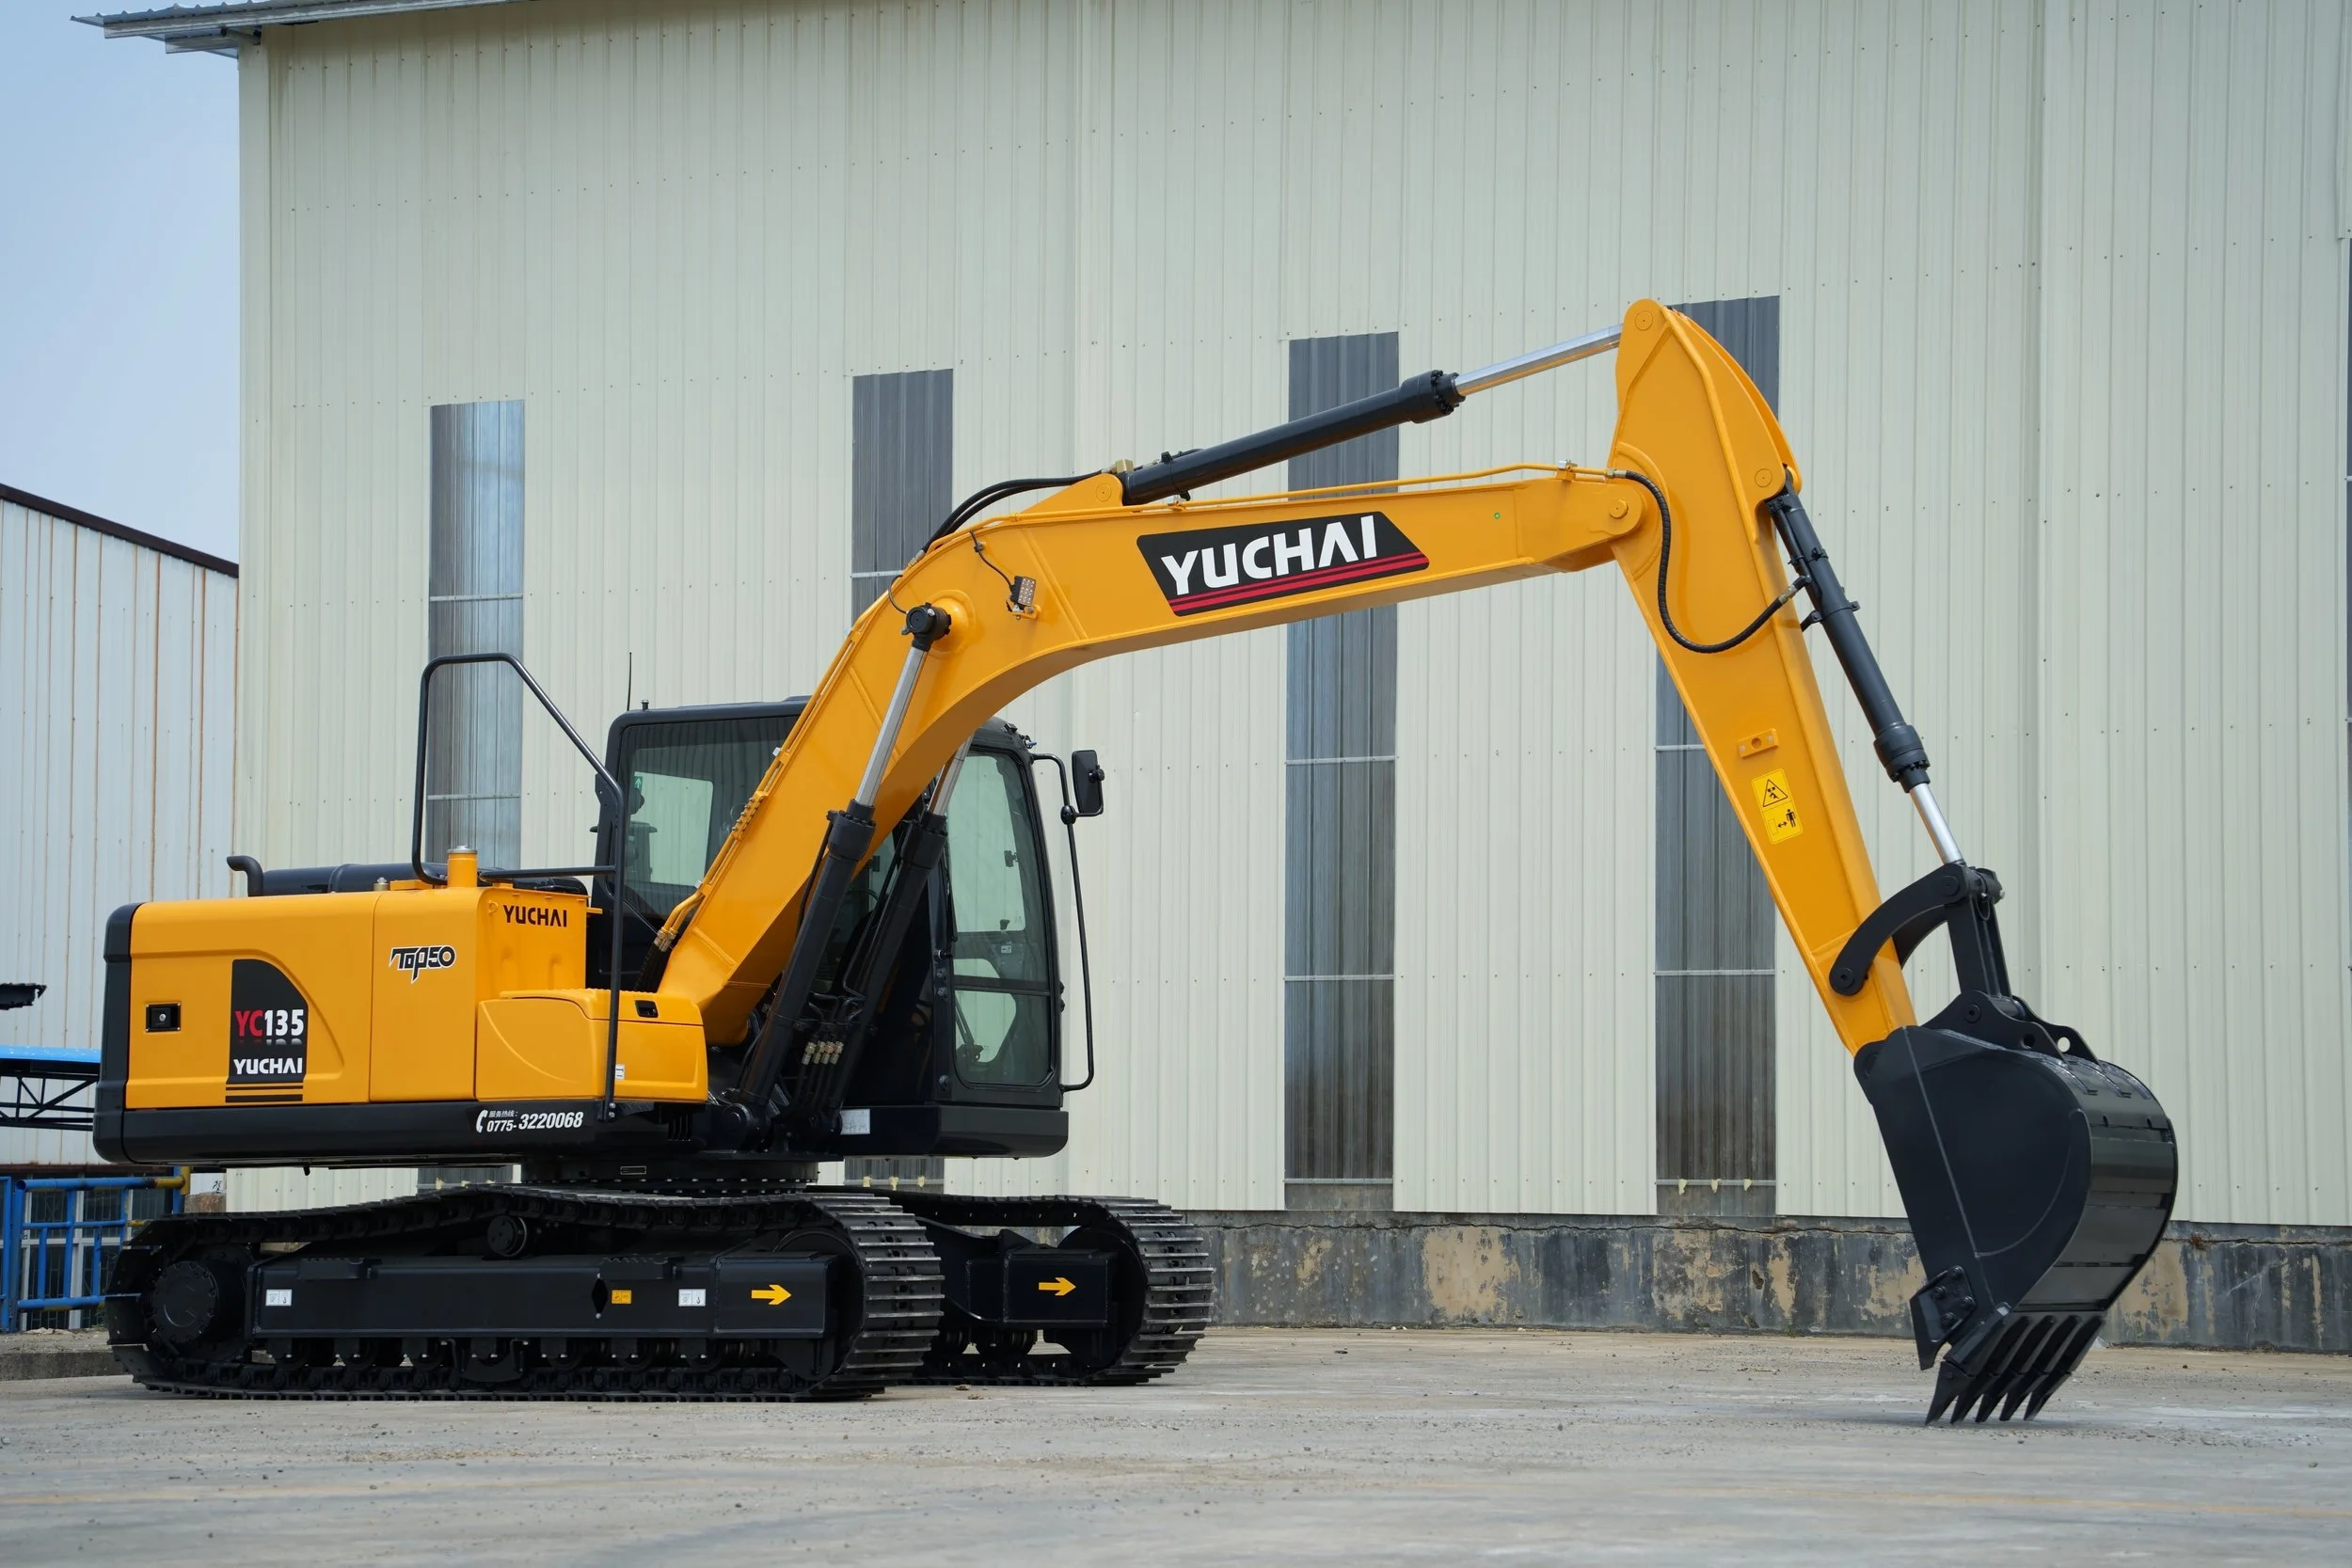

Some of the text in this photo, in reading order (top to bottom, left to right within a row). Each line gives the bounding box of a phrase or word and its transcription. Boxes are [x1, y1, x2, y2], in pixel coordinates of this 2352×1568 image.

[1161, 515, 1378, 595] YUCHAI
[503, 905, 568, 927] YUCHAI
[234, 1008, 305, 1037] YC135
[233, 1057, 303, 1075] YUCHAI
